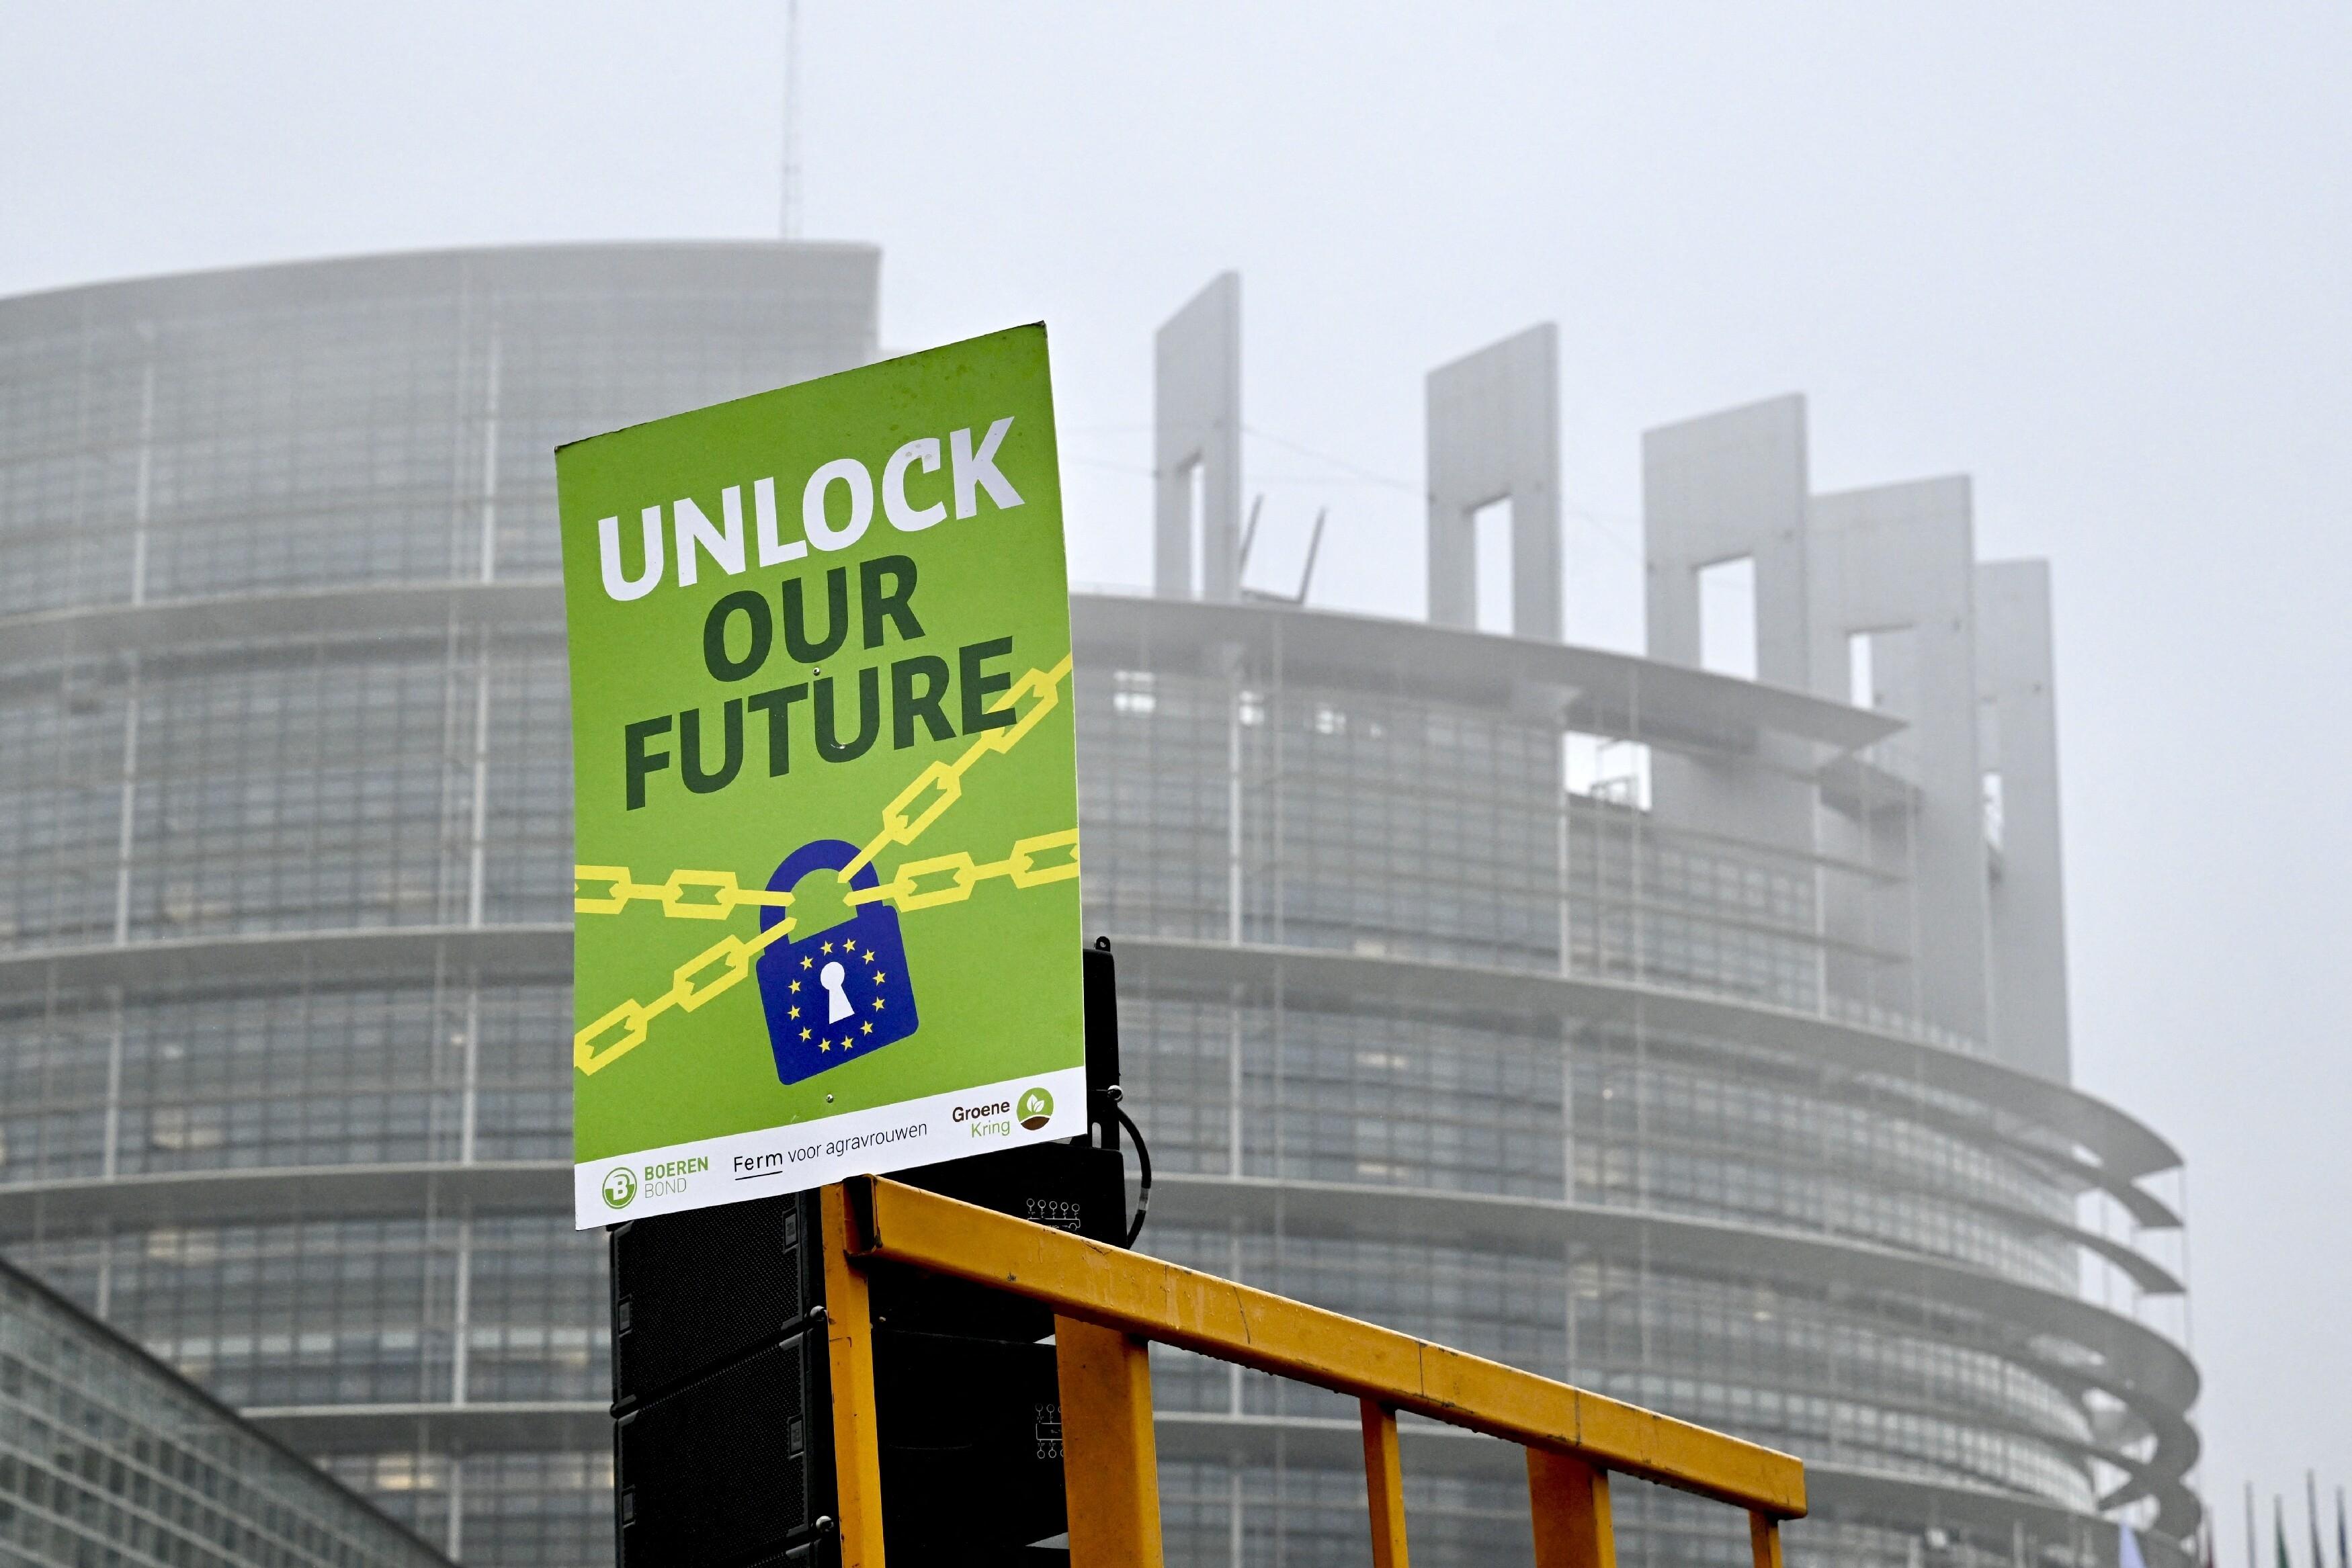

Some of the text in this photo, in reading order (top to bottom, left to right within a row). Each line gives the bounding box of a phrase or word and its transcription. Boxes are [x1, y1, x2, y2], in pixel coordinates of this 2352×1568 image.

[598, 417, 1025, 601] UNLOCK
[704, 556, 925, 683] OUR
[625, 636, 1017, 811] FUTURE
[952, 1100, 1010, 1123] Groene
[972, 1120, 1010, 1138] Kring
[734, 1123, 927, 1172] Ferm voor agravrouwen
[644, 1156, 708, 1181] BOEREN
[644, 1178, 687, 1199] BOND
